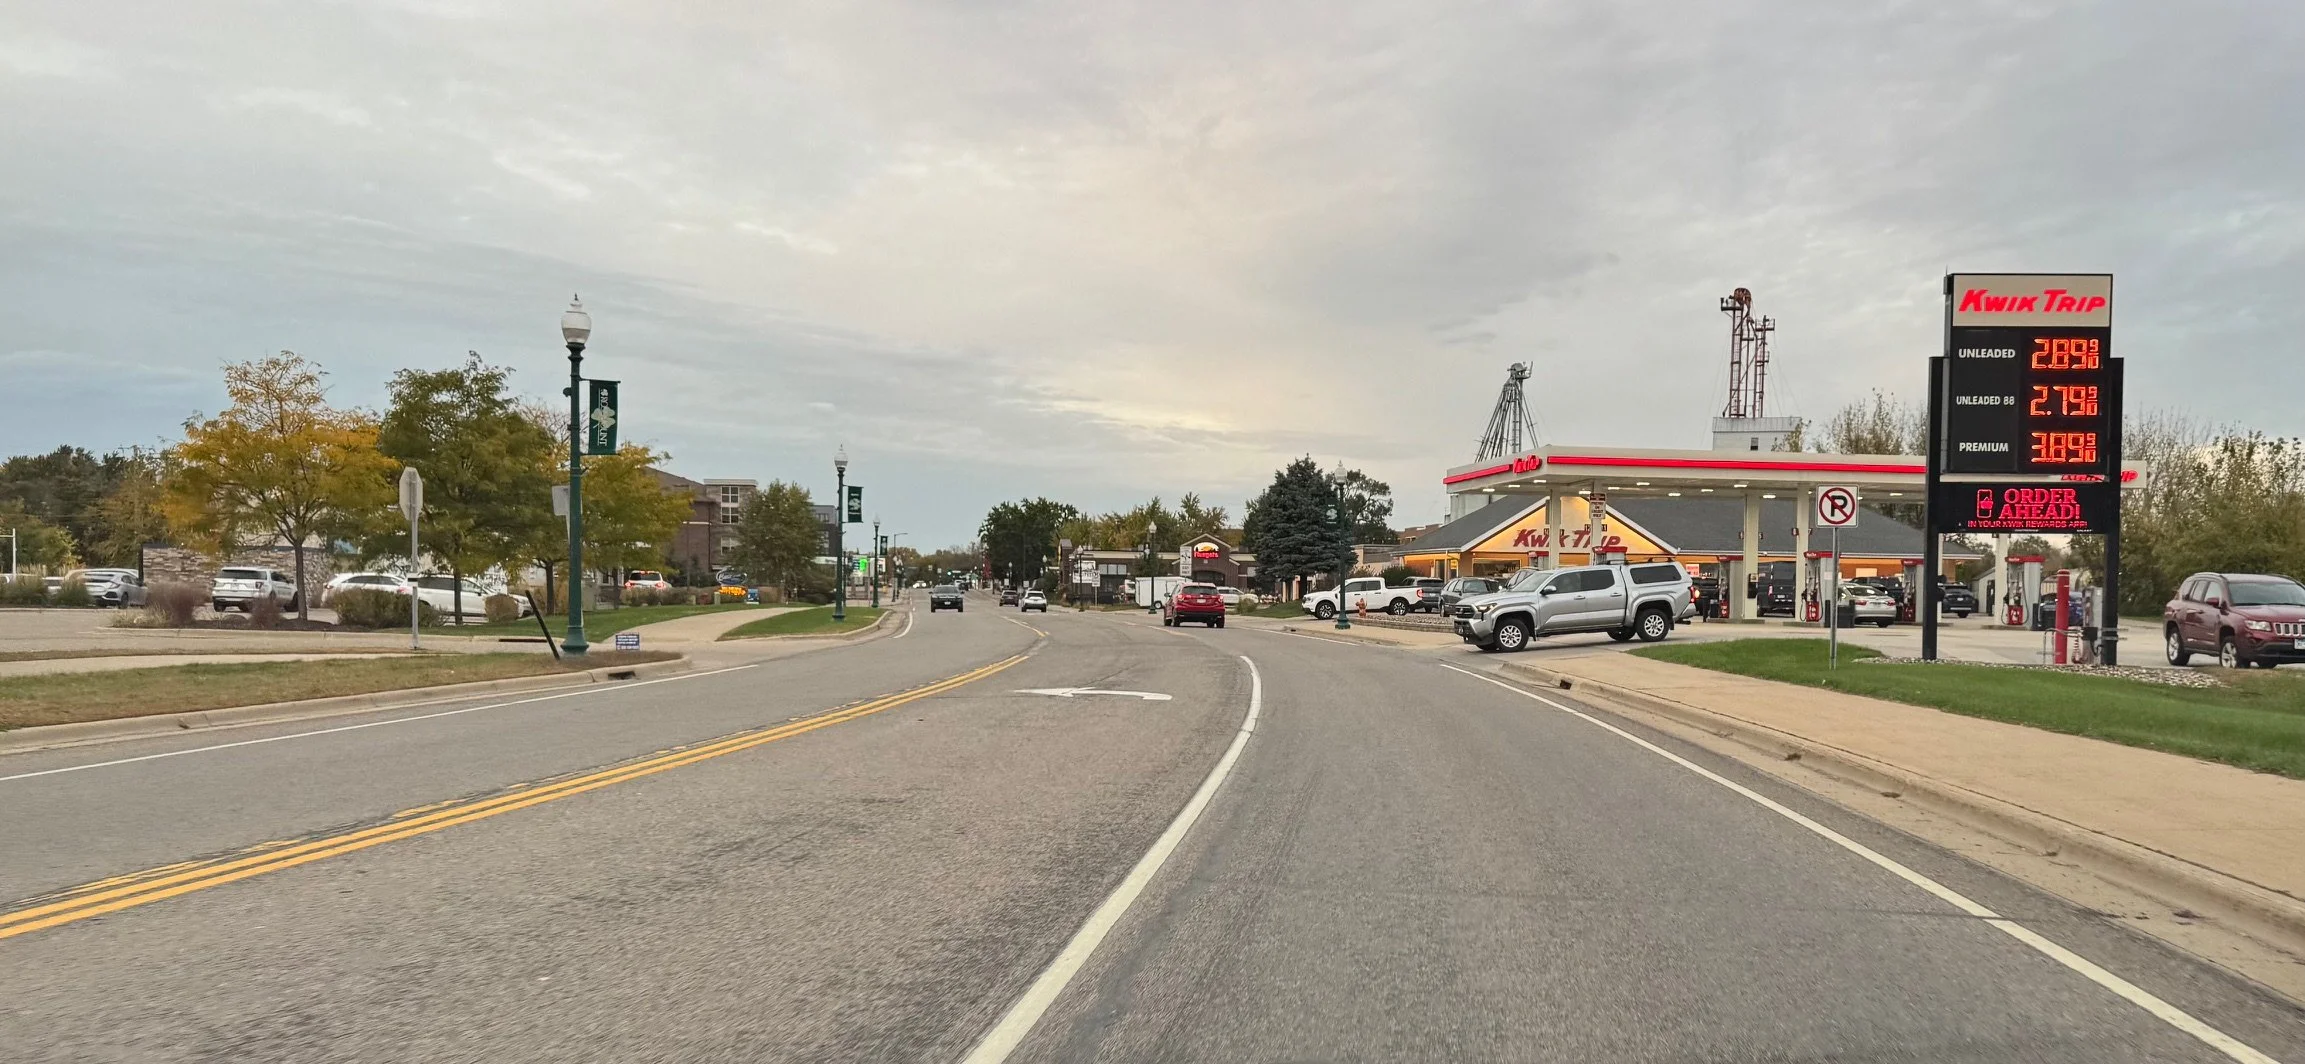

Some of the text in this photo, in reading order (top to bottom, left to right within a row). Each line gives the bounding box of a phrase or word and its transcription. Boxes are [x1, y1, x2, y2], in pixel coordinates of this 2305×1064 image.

[1958, 289, 2106, 313] KWIK TRIP
[1958, 348, 2016, 359] UNLEADED
[2031, 338, 2087, 369] 2.89
[1956, 395, 2001, 406] UNLEADED
[2003, 395, 2015, 406] 88
[2030, 386, 2086, 416] 2.79
[1959, 442, 2009, 452] PREMIUM
[2031, 432, 2085, 463] 3.89
[1830, 495, 1848, 517] P
[2003, 488, 2078, 504] ORDER
[1998, 504, 2081, 520] AHEAD!
[1967, 520, 2088, 528] IN YOUR KWIK REWARDS APP!
